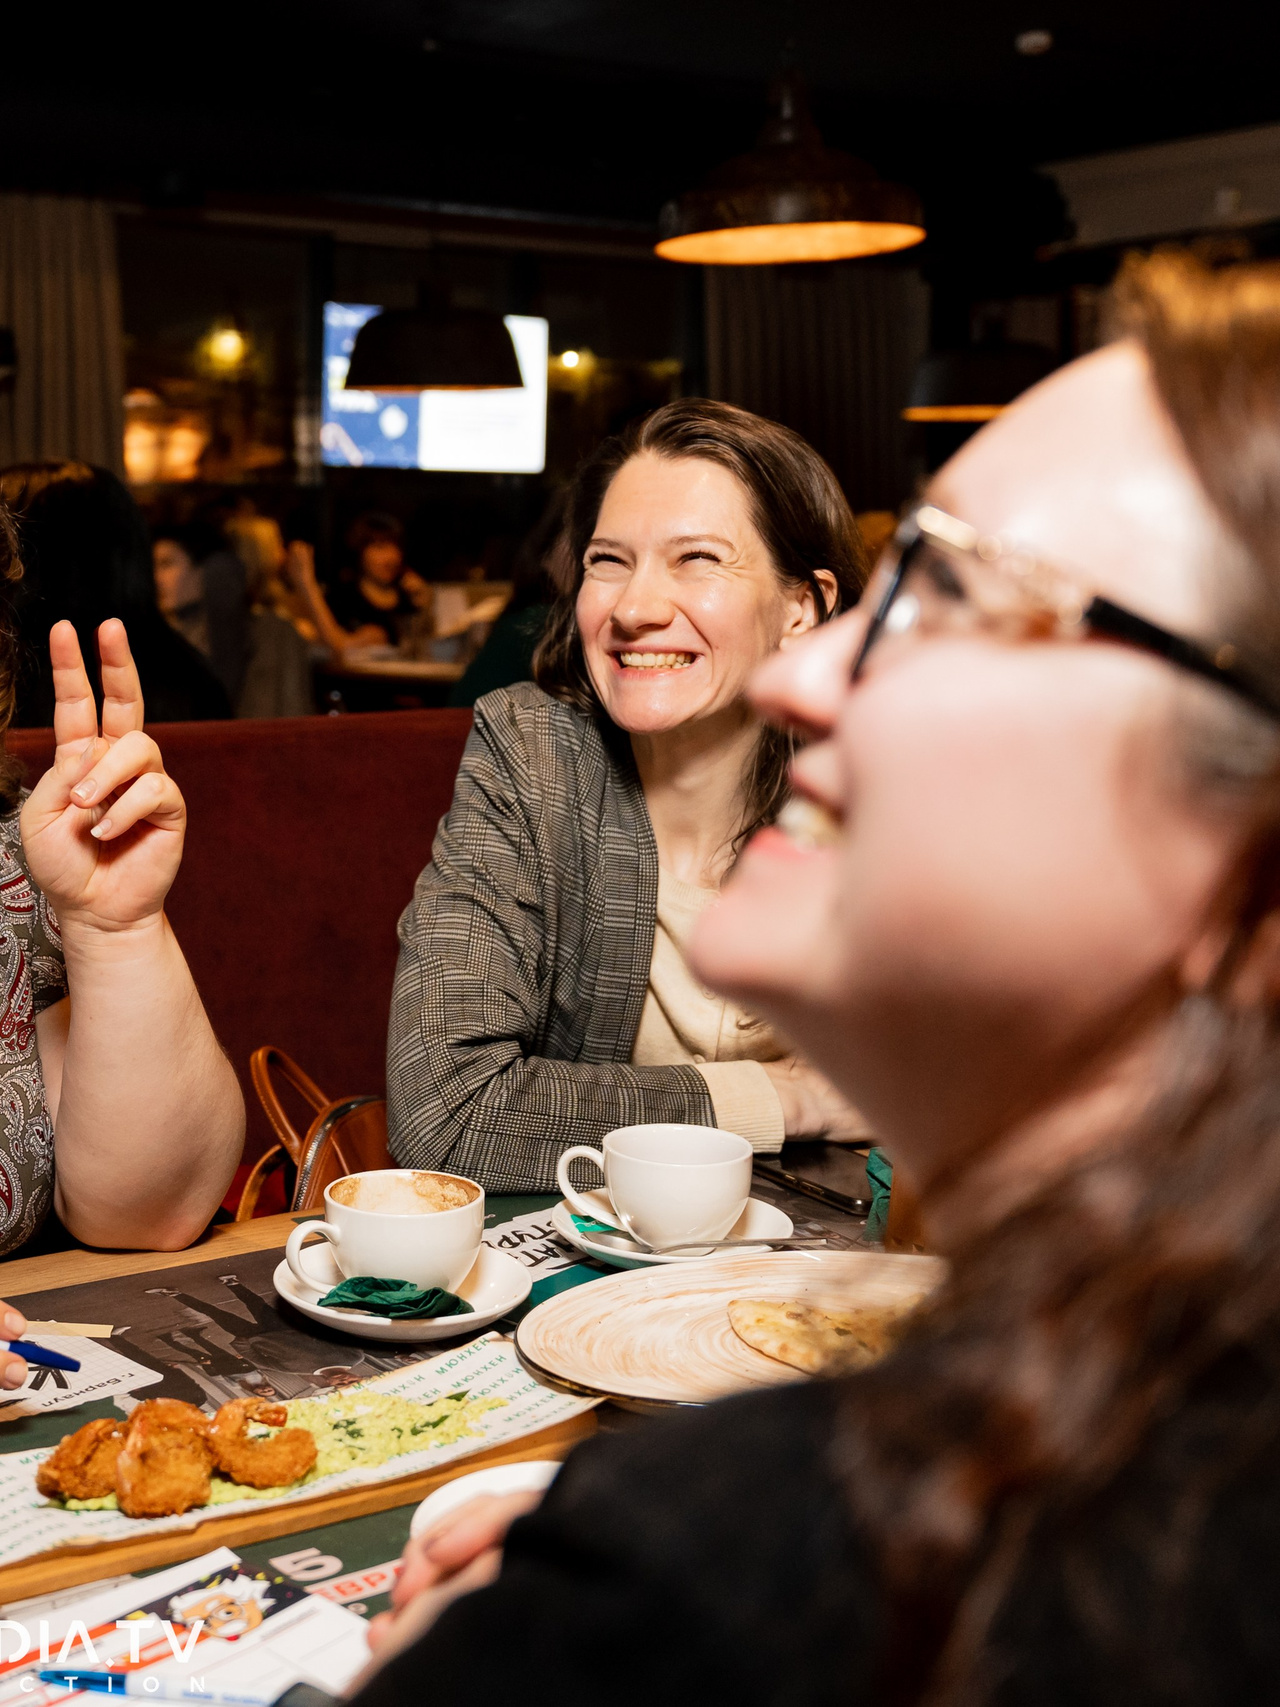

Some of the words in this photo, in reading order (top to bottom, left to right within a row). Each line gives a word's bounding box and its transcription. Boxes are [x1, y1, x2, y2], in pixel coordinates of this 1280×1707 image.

[435, 1337, 489, 1376] МЮНХЕН
[451, 1354, 506, 1389] МЮНХЕН
[41, 1377, 122, 1407] Барнаул
[503, 1392, 558, 1423] МЮНХЕН
[268, 1547, 343, 1581] 5
